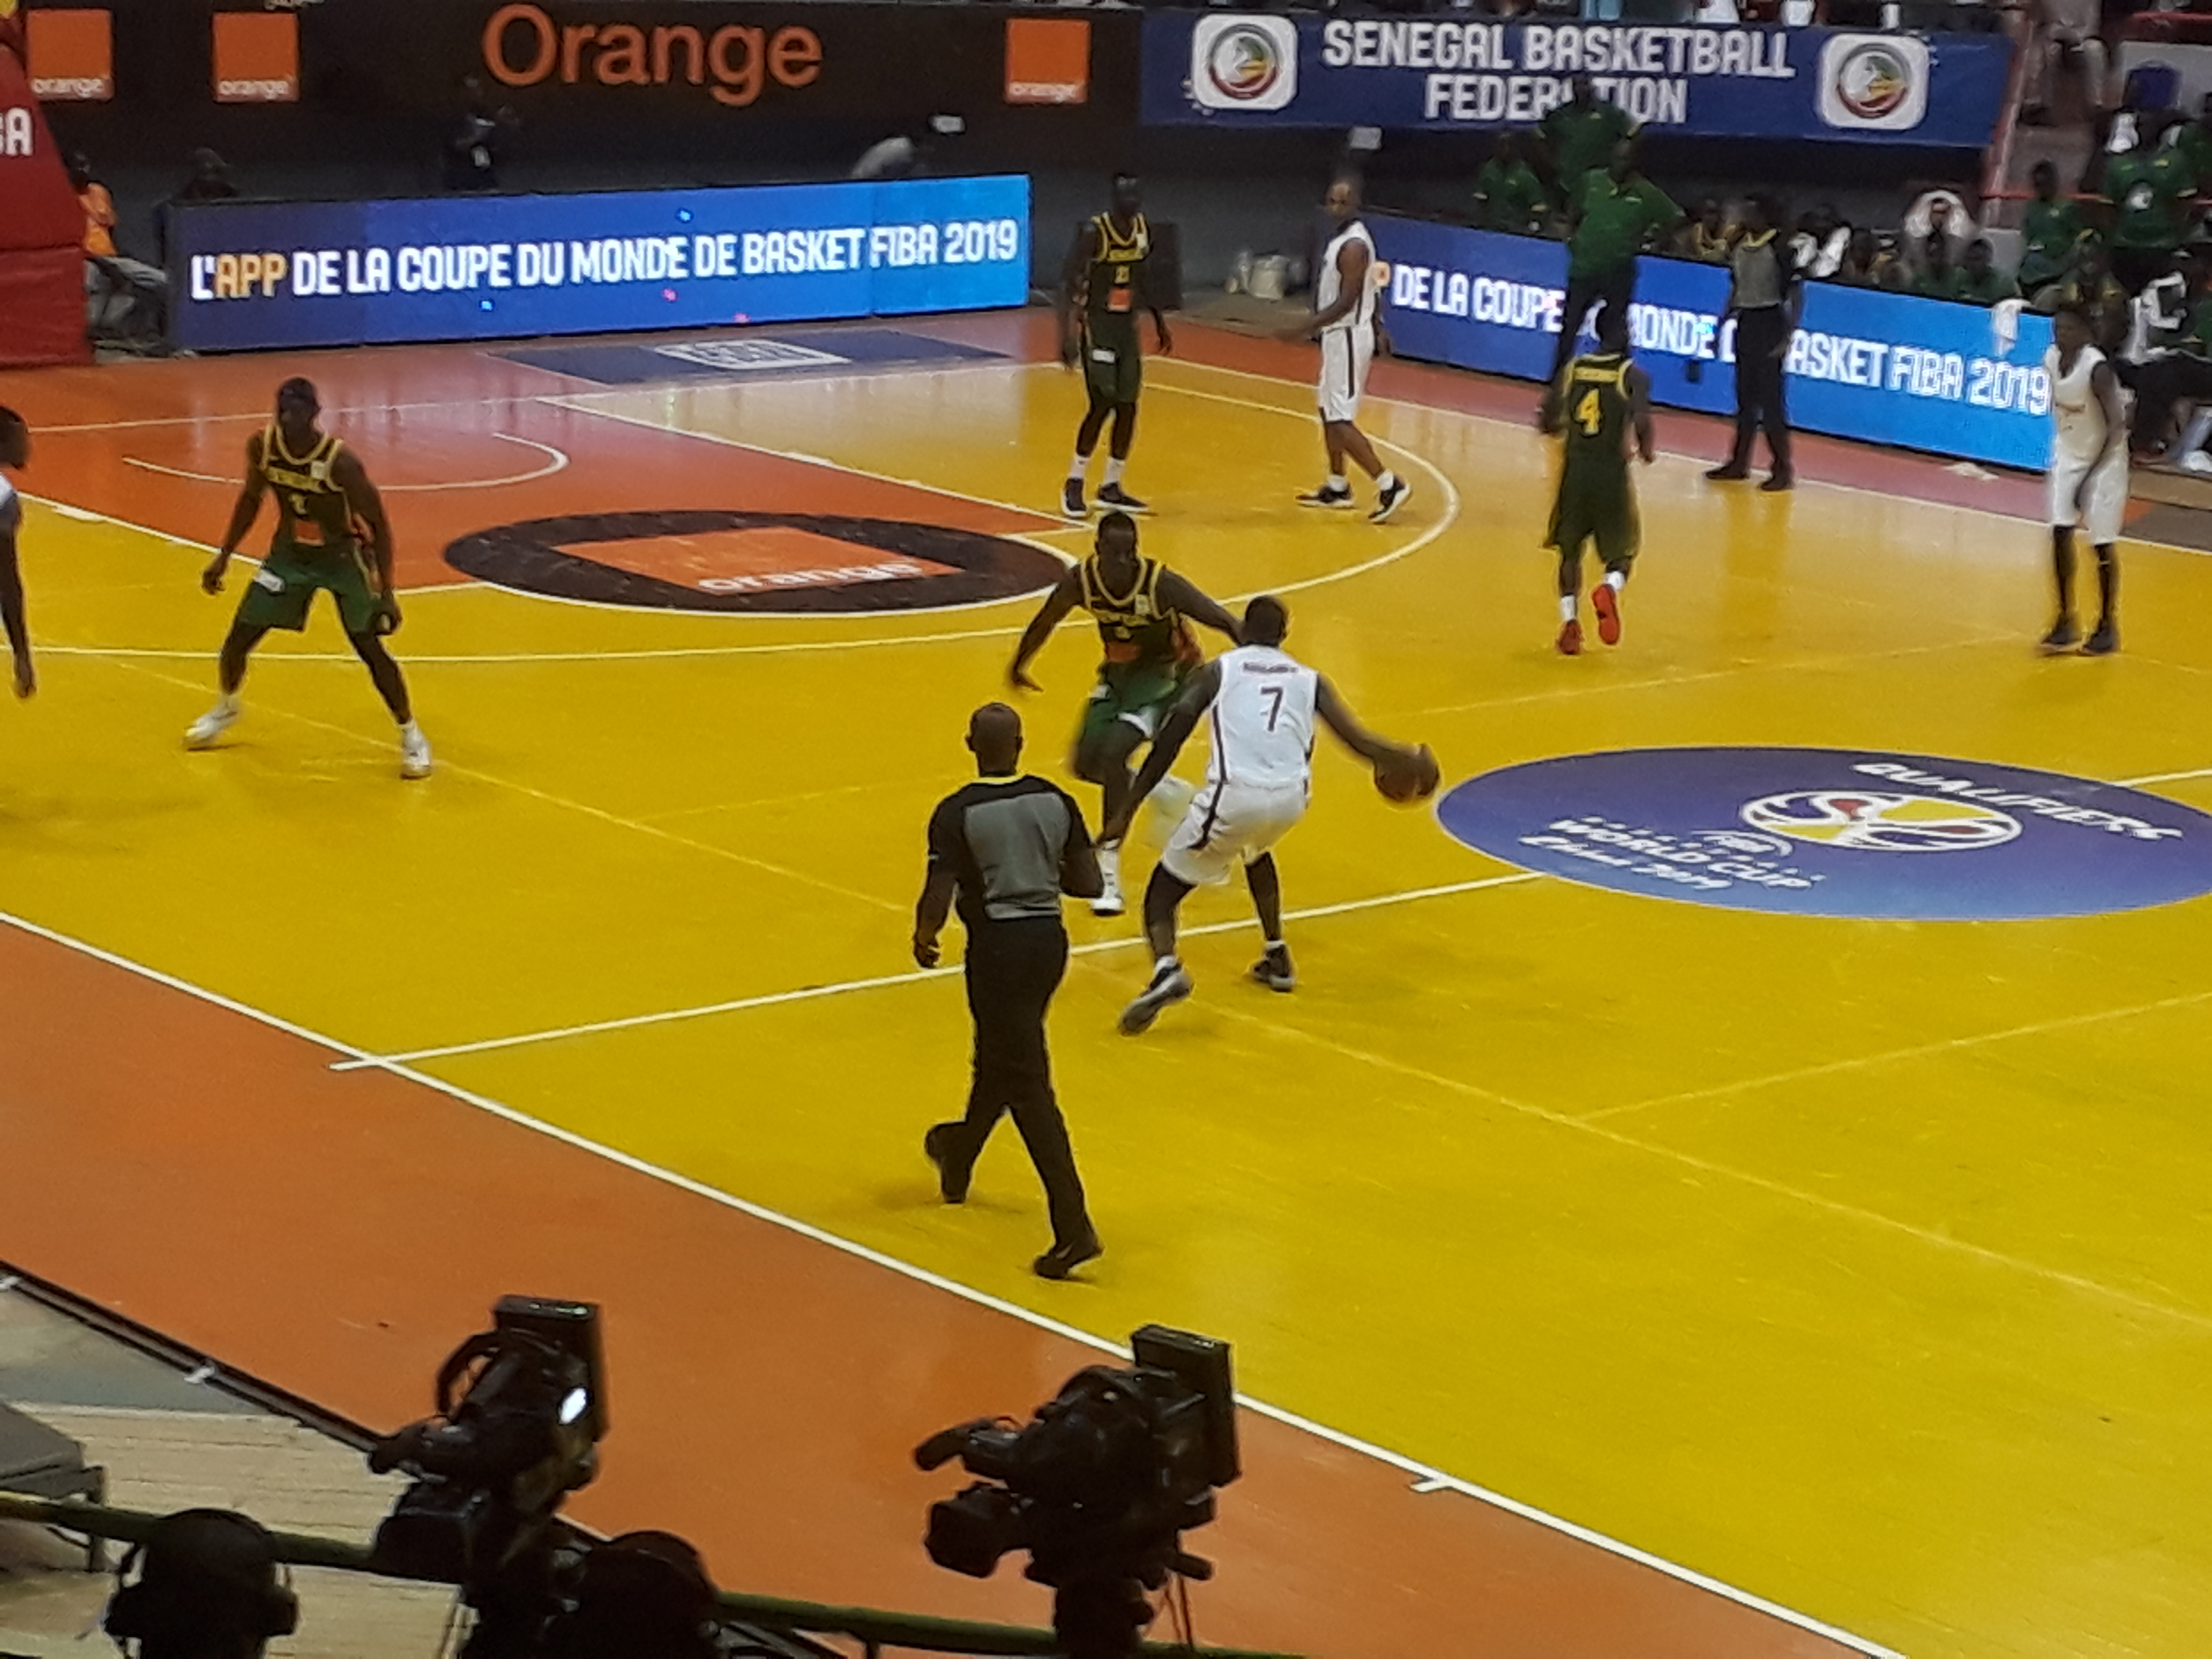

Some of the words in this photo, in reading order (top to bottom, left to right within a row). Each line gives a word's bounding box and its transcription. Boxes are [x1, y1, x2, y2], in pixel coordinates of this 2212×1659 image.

[482, 3, 823, 106] Orange
[1322, 20, 1513, 70] SENEGAL
[1523, 25, 1796, 78] BASKETBALL
[32, 78, 104, 98] orange
[218, 80, 289, 100] orange
[190, 252, 288, 301] L'APP
[292, 250, 342, 296] DE
[347, 248, 391, 293] LA
[397, 244, 511, 291] COUPE
[517, 242, 565, 287] DU
[570, 236, 689, 285] MONDE
[694, 234, 738, 278] DE
[742, 228, 865, 274] BASKET
[869, 225, 939, 268] FIBA
[943, 220, 1018, 264] 2019
[1392, 263, 1431, 309] DE
[1432, 271, 1469, 317] LA
[1473, 277, 1566, 333] COUPE
[1783, 329, 1888, 387] ASKET
[1888, 345, 1964, 400] FIBA
[1967, 357, 2052, 416] 2019
[1575, 387, 1601, 434] 4
[698, 560, 924, 594] orange
[1260, 686, 1283, 733] 7
